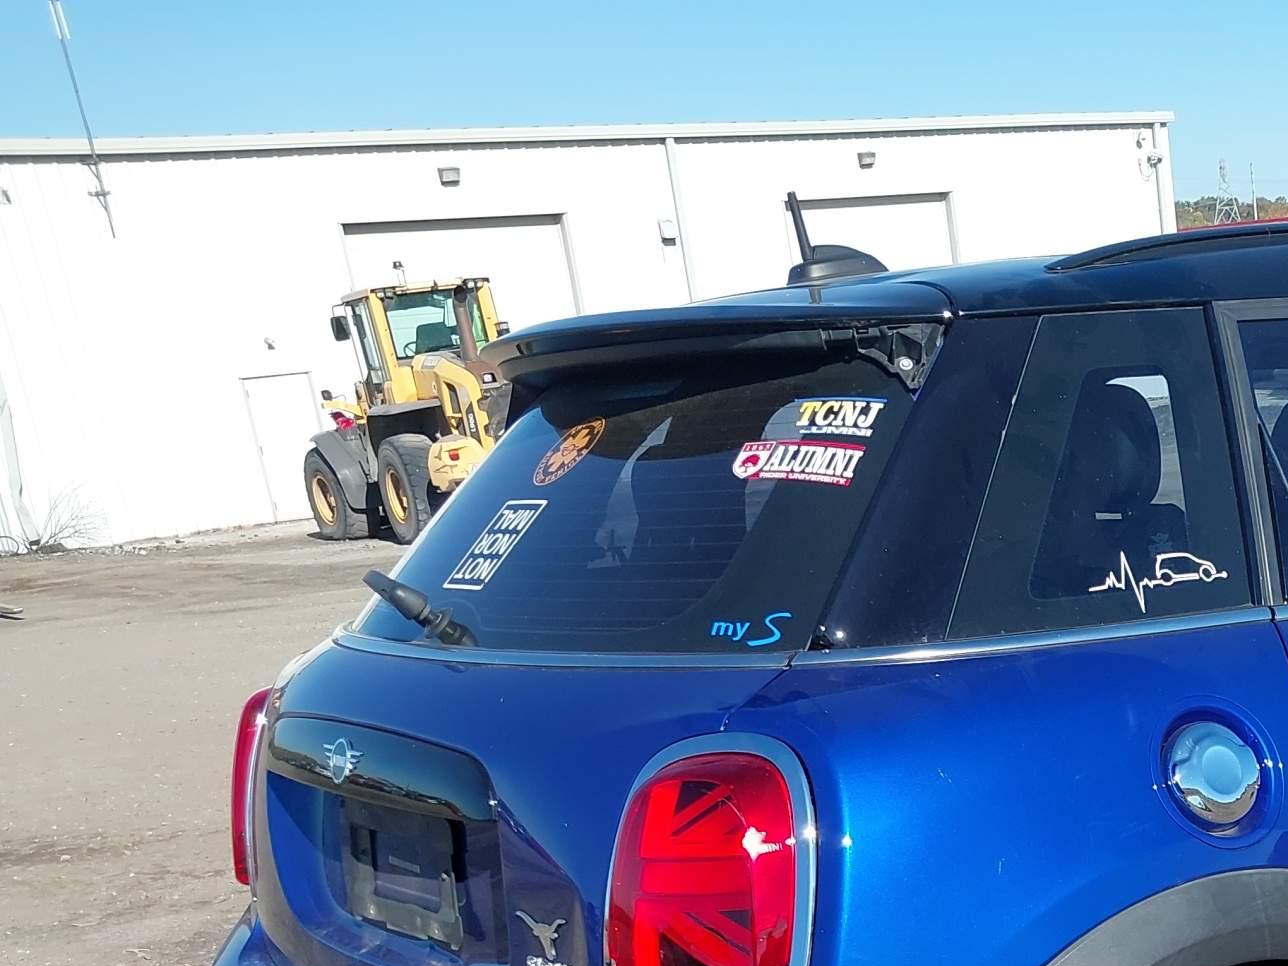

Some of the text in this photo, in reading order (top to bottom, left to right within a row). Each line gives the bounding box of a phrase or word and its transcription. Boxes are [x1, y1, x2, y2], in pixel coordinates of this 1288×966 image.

[796, 401, 884, 428] TCNJ
[762, 445, 864, 479] ALUMNI
[495, 509, 535, 531] MAL
[474, 533, 517, 555] NOR
[454, 558, 499, 580] NOT
[711, 612, 793, 647] my S
